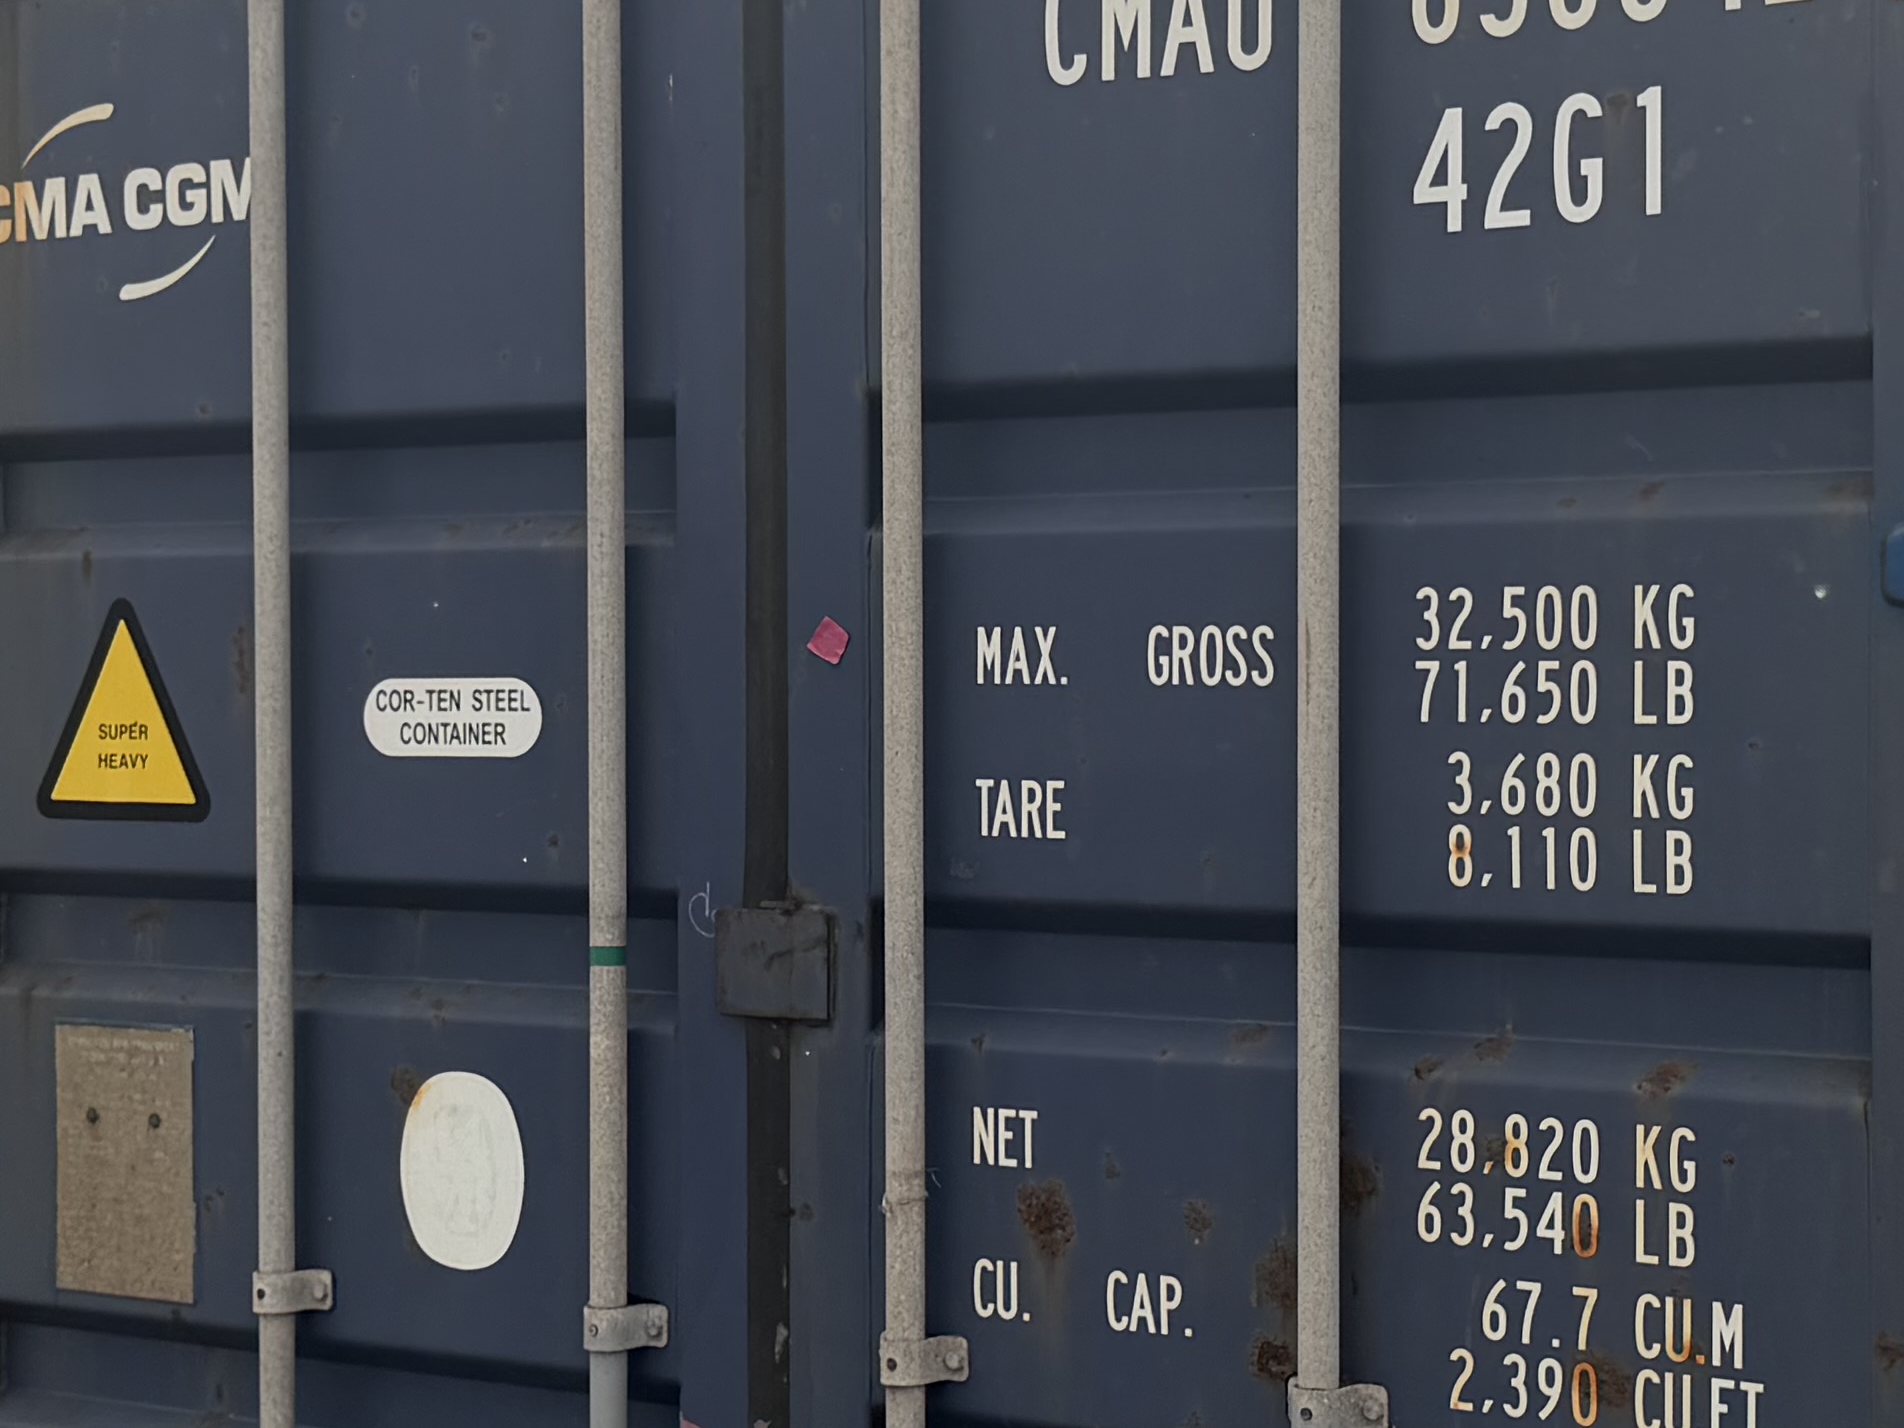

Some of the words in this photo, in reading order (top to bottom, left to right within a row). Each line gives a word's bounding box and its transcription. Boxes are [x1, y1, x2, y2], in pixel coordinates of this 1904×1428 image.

[124, 157, 251, 230] CGM
[1414, 86, 1663, 233] 42G1
[977, 627, 1068, 684] MAX.
[1147, 625, 1275, 687] GROSS
[1415, 585, 1597, 650] 32,500
[1634, 583, 1695, 650] KG
[98, 721, 148, 740] SUPER
[375, 689, 461, 712] COR-TEN
[471, 689, 530, 712] STEEL
[1415, 660, 1597, 724] 71,650
[1634, 660, 1694, 725] LB
[98, 753, 148, 769] HEAVY
[399, 722, 506, 745] CONTAINER
[976, 779, 1066, 839] TARE
[1447, 751, 1597, 818] 3,680
[1633, 754, 1694, 820] KG
[1448, 823, 1597, 892] 8,110
[1633, 829, 1693, 895] LB
[974, 1107, 1038, 1169] NET
[1417, 1108, 1600, 1184] 28,820
[1636, 1123, 1696, 1193] KG
[1417, 1181, 1599, 1258] 63,540
[1636, 1199, 1695, 1268] LB
[974, 1259, 1031, 1322] CU.
[1106, 1271, 1193, 1337] CAP.
[1482, 1279, 1598, 1350] 67.7
[1635, 1293, 1744, 1369] CU.M
[1449, 1348, 1598, 1427] 2,390
